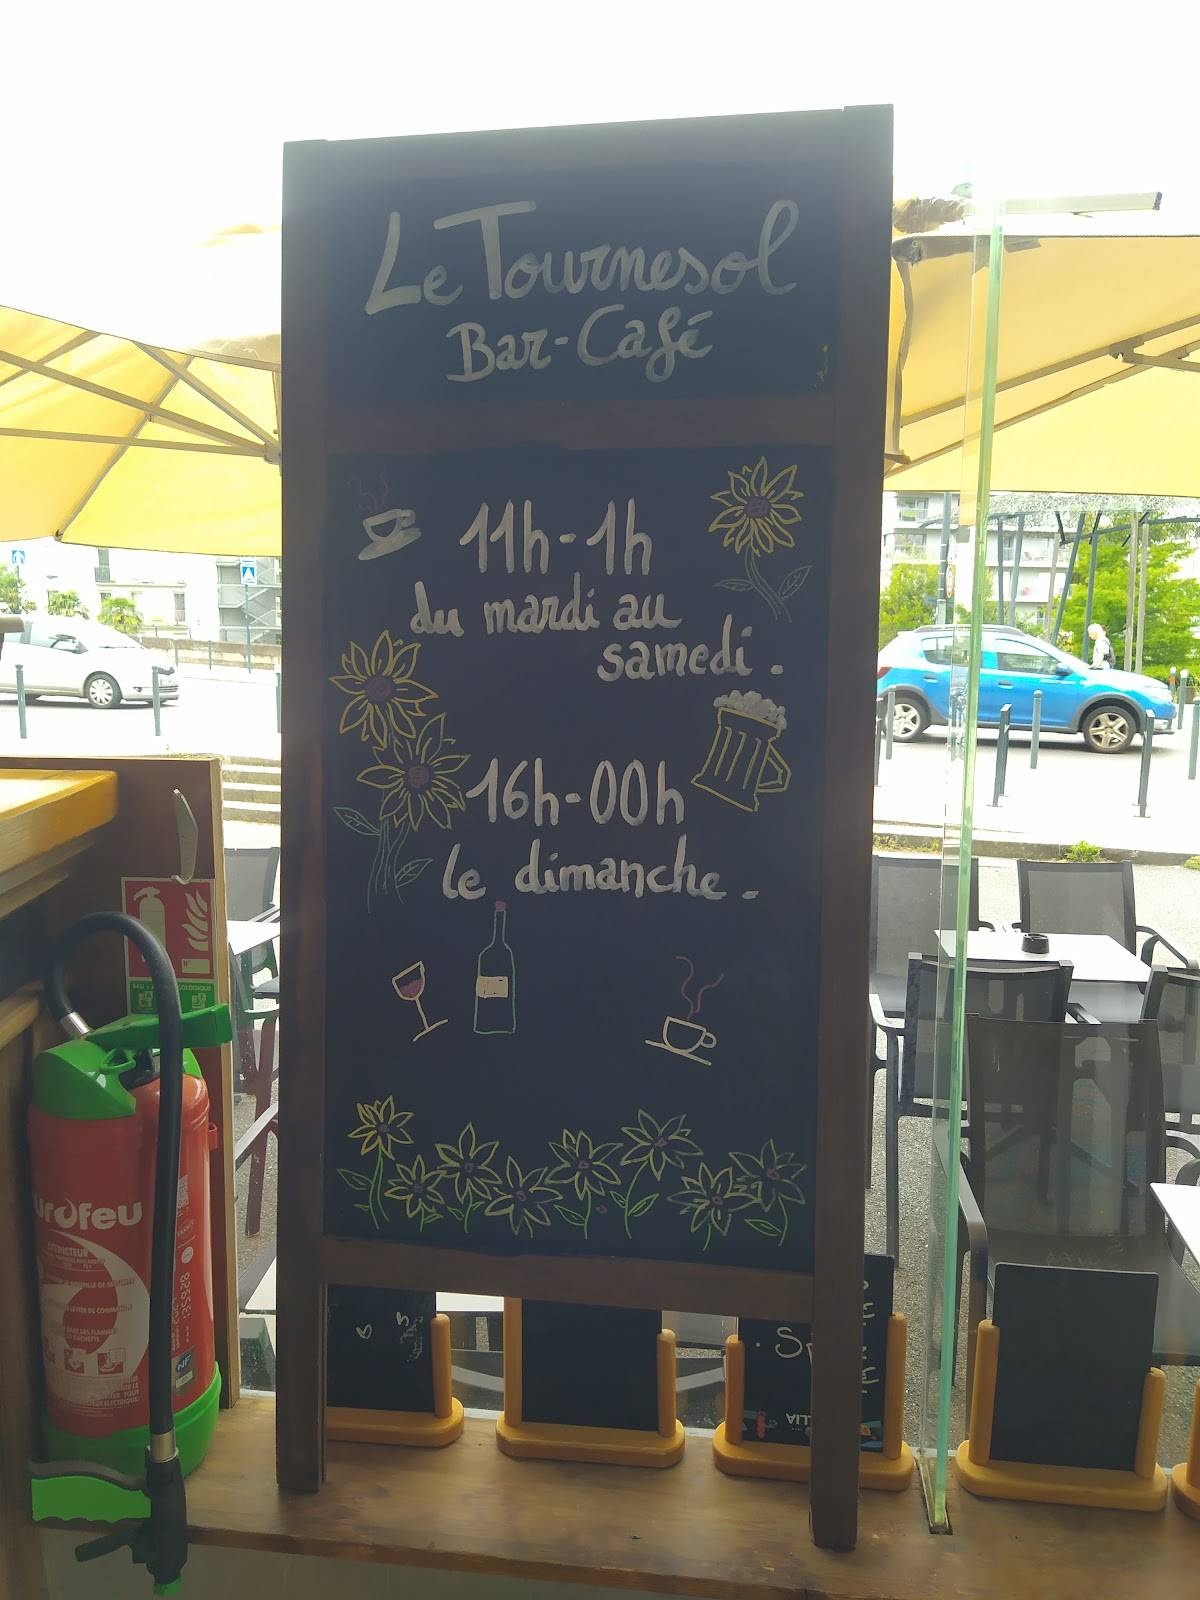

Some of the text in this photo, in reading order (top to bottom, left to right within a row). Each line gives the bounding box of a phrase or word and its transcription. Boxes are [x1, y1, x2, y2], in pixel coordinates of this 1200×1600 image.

[364, 200, 798, 315] Le Tournesol
[446, 303, 713, 382] Bar-Café
[410, 572, 682, 637] du mardi au
[442, 843, 488, 900] le
